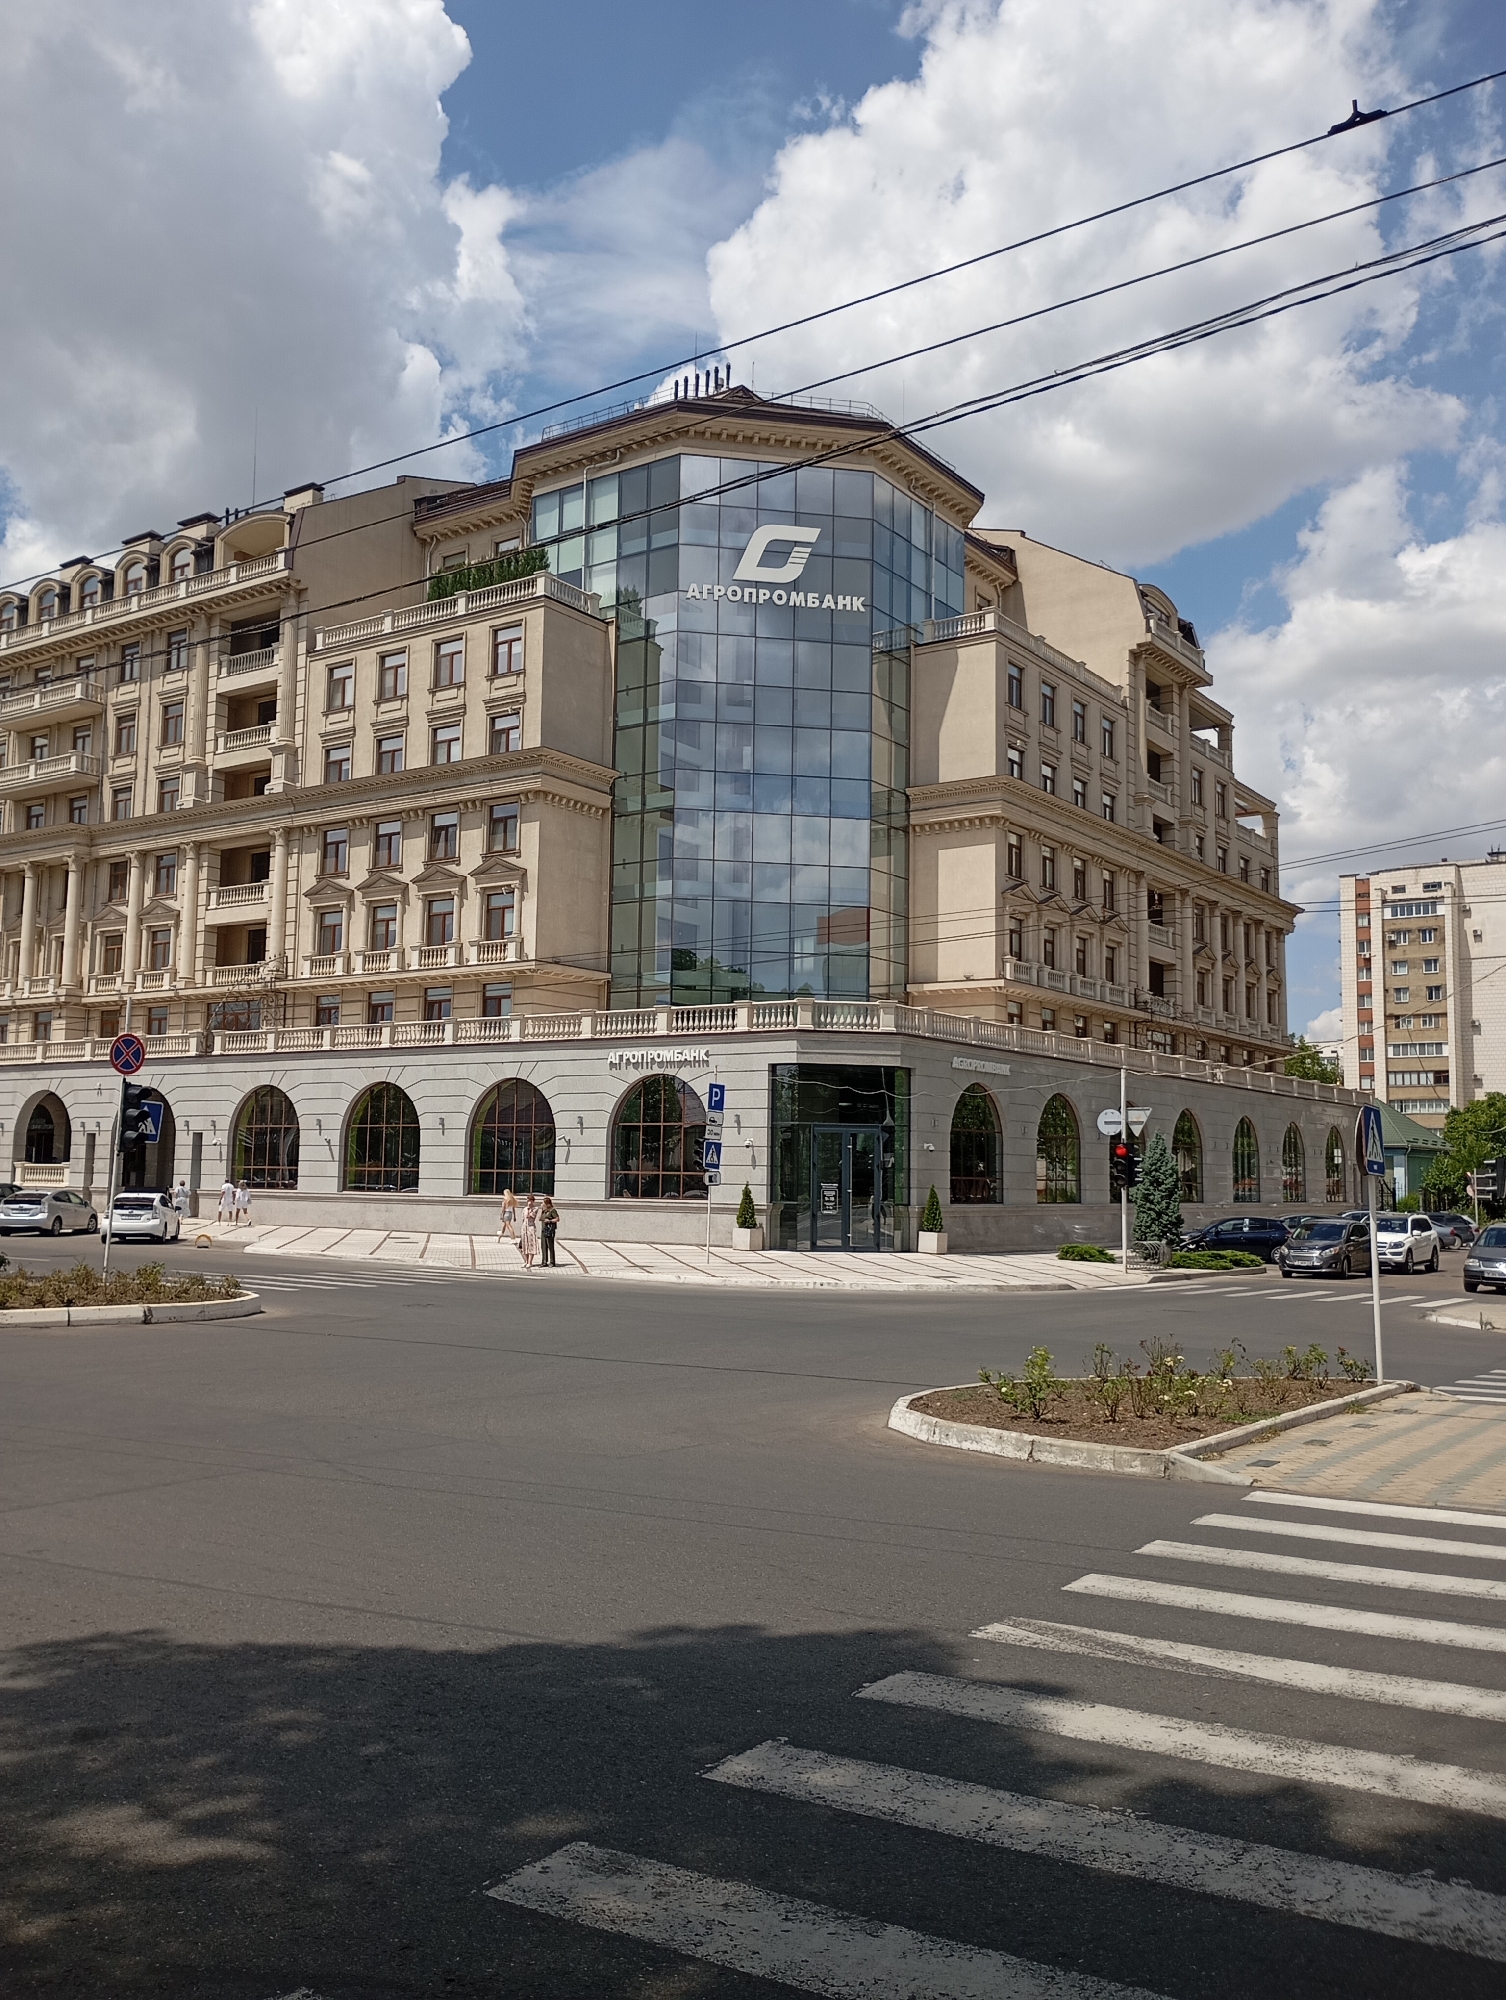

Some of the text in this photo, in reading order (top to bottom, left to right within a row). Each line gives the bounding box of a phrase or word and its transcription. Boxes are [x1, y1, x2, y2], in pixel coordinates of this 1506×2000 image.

[686, 583, 866, 612] АГРОПРОМБАНК
[608, 1049, 709, 1064] АГРОПРОМБАНК
[712, 1088, 721, 1106] P
